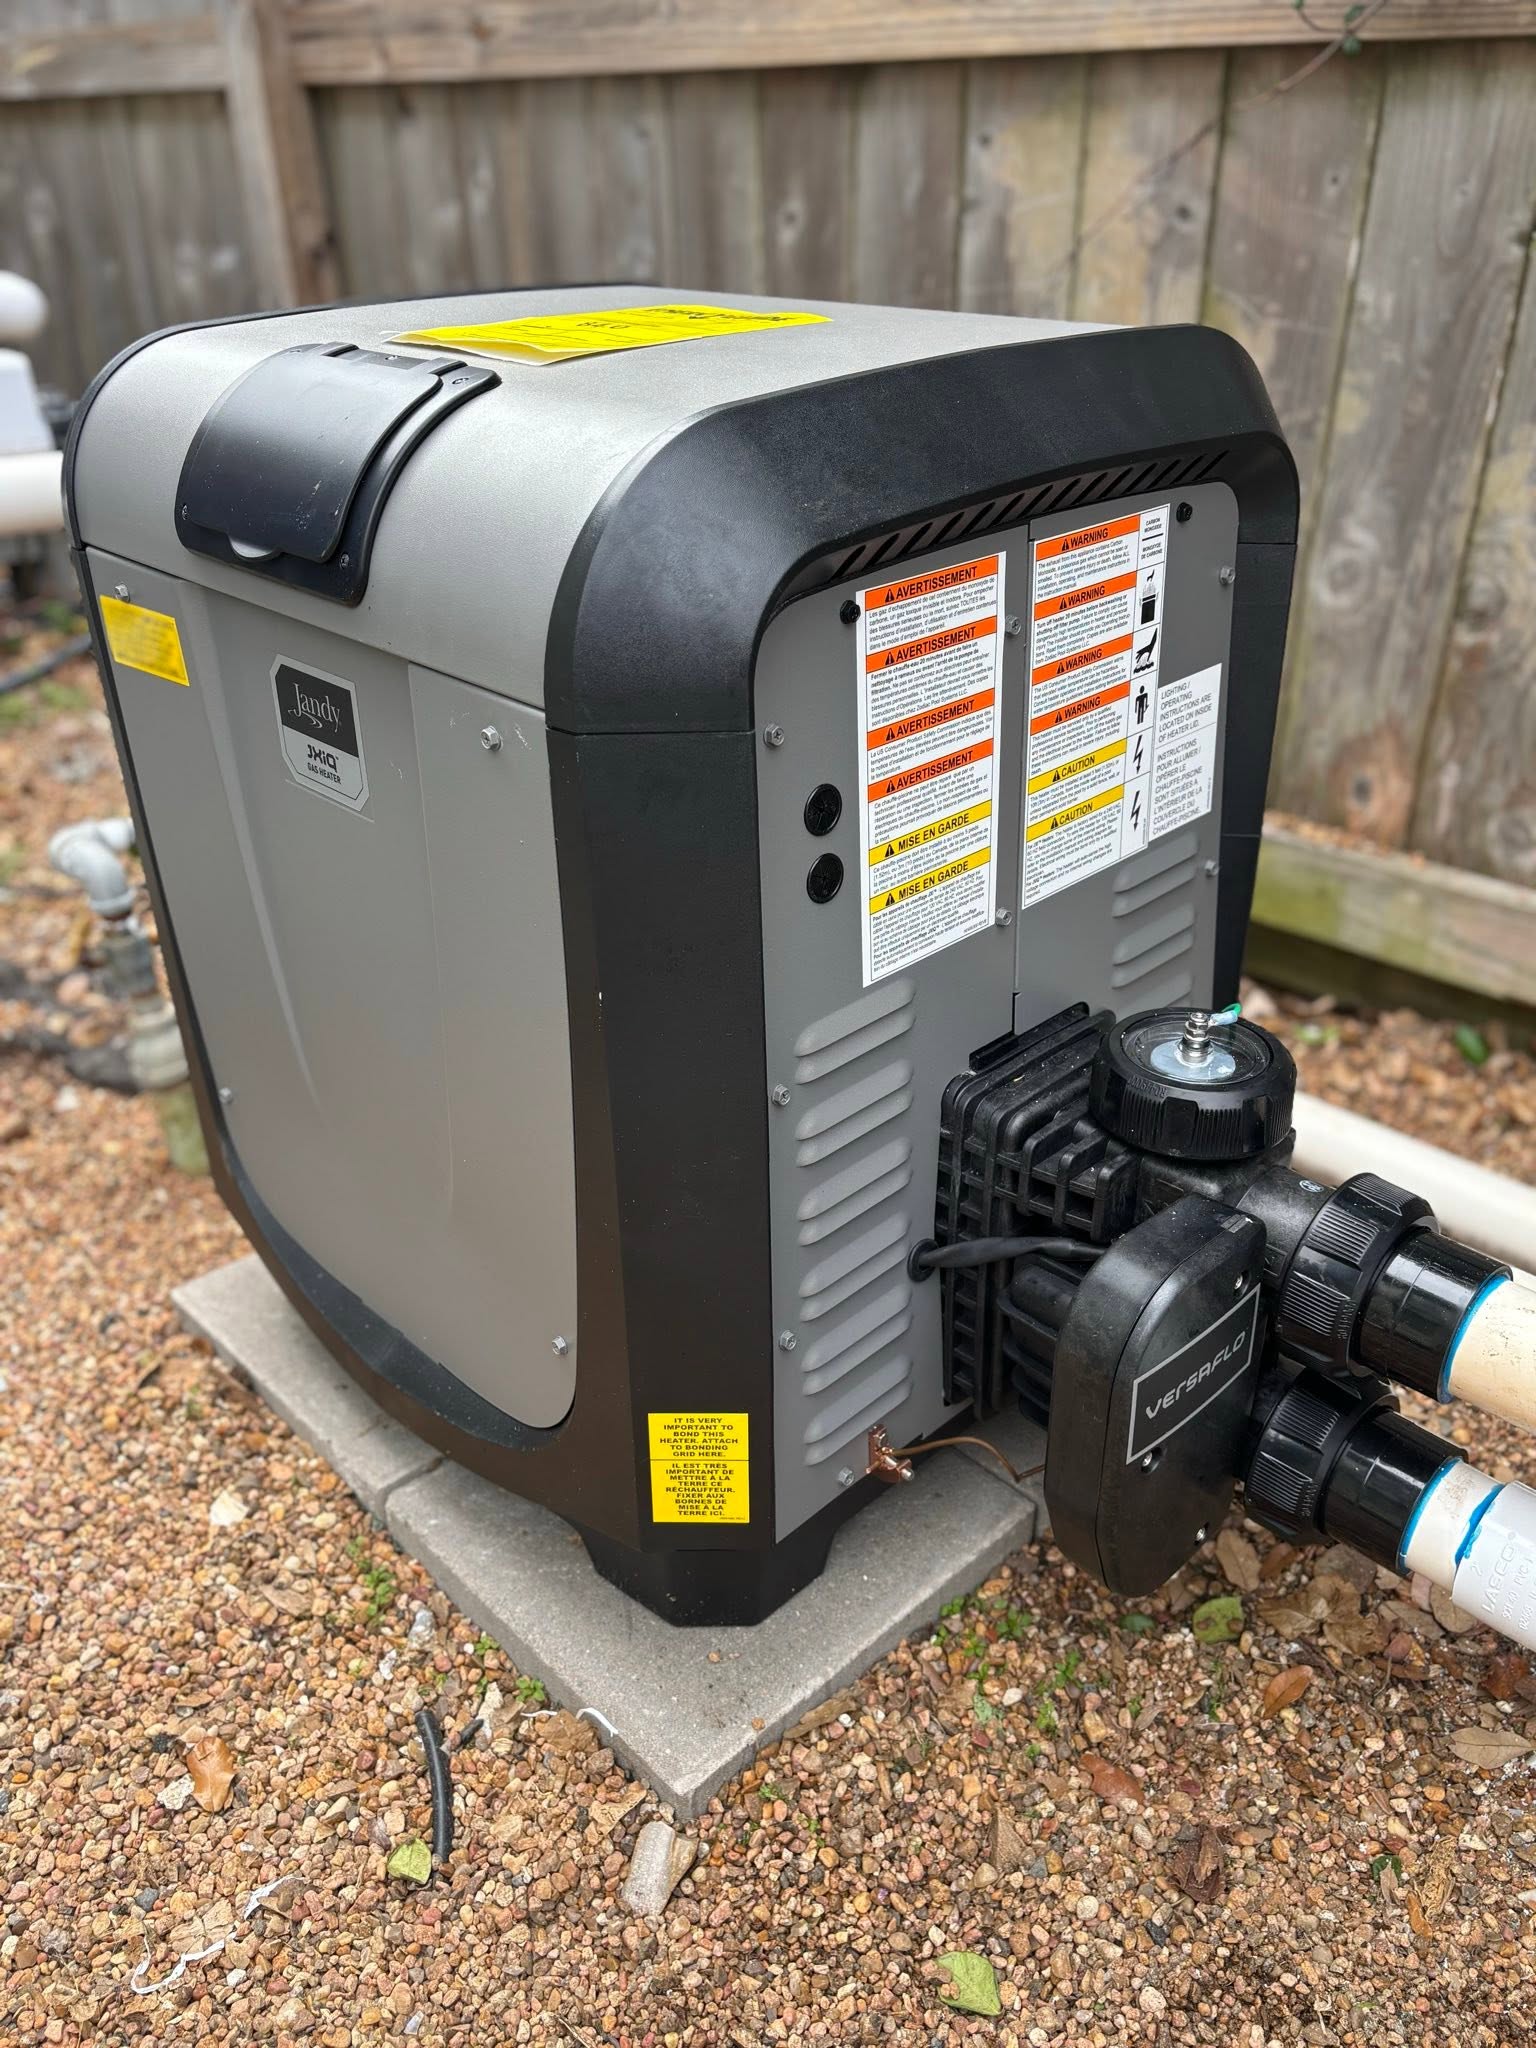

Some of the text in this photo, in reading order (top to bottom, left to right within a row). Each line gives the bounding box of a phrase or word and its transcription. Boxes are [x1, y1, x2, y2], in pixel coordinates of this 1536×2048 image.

[1071, 528, 1108, 548] WARNING
[896, 566, 977, 599] AVERTISSEMENT
[1068, 585, 1105, 607] WARNING
[896, 626, 976, 662] AVERTISSEMENT
[1066, 648, 1102, 671] WARNING
[288, 683, 340, 732] Jandy
[897, 700, 974, 737] AVERTISSEMENT
[1064, 696, 1101, 719] WARNING
[307, 762, 341, 785] GAS HEATER
[897, 750, 973, 789] AVERTISSEMENT
[1062, 755, 1095, 778] CAUTION
[1060, 802, 1093, 826] CAUTION
[899, 813, 969, 852] MISE EN GARDE
[899, 860, 968, 900] MISE EN GARDE
